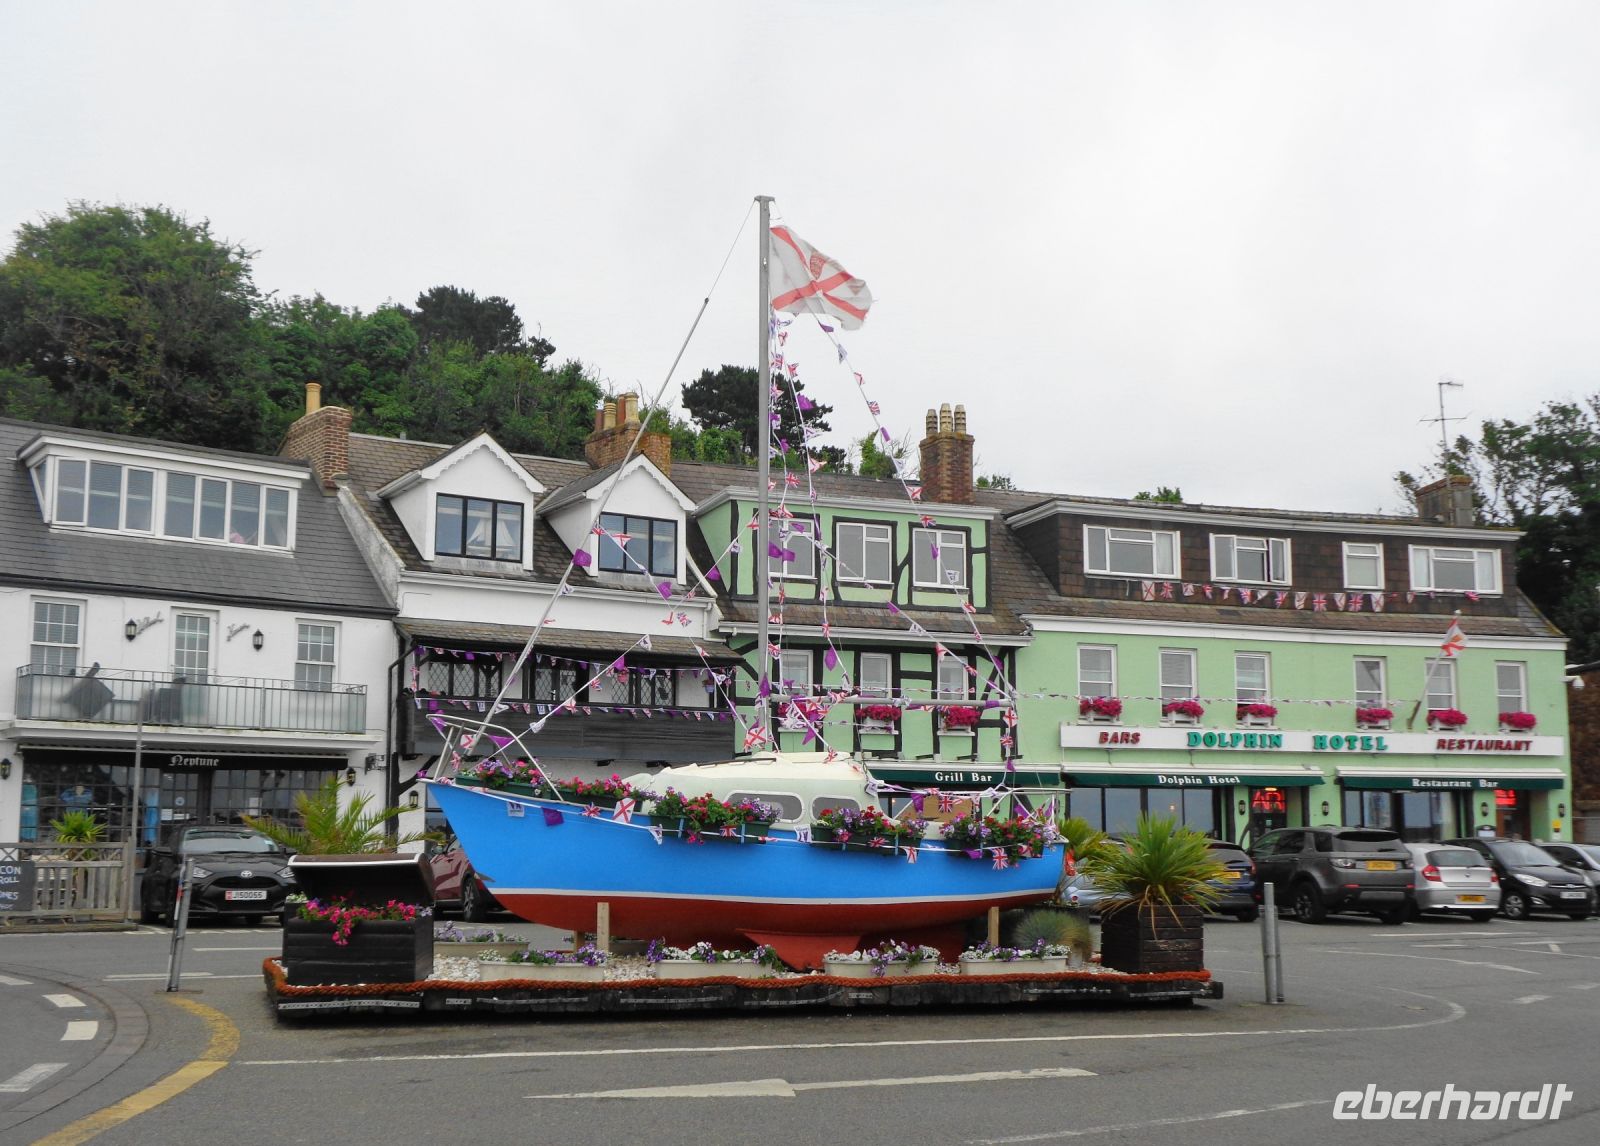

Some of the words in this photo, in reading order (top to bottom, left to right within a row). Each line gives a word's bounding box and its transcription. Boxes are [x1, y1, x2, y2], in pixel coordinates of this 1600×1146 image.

[1098, 731, 1141, 744] BARS
[1186, 732, 1283, 748] DOLPHIN
[1312, 734, 1388, 751] HOTEL
[1436, 738, 1533, 751] RESTAURANT
[168, 754, 219, 766] Neptune
[935, 771, 963, 782] Grill
[972, 772, 993, 782] Bar
[1158, 775, 1203, 786] Dolphin
[1208, 775, 1241, 784] Hotel
[1412, 778, 1472, 788] Restaurant
[1480, 779, 1500, 788] Bar
